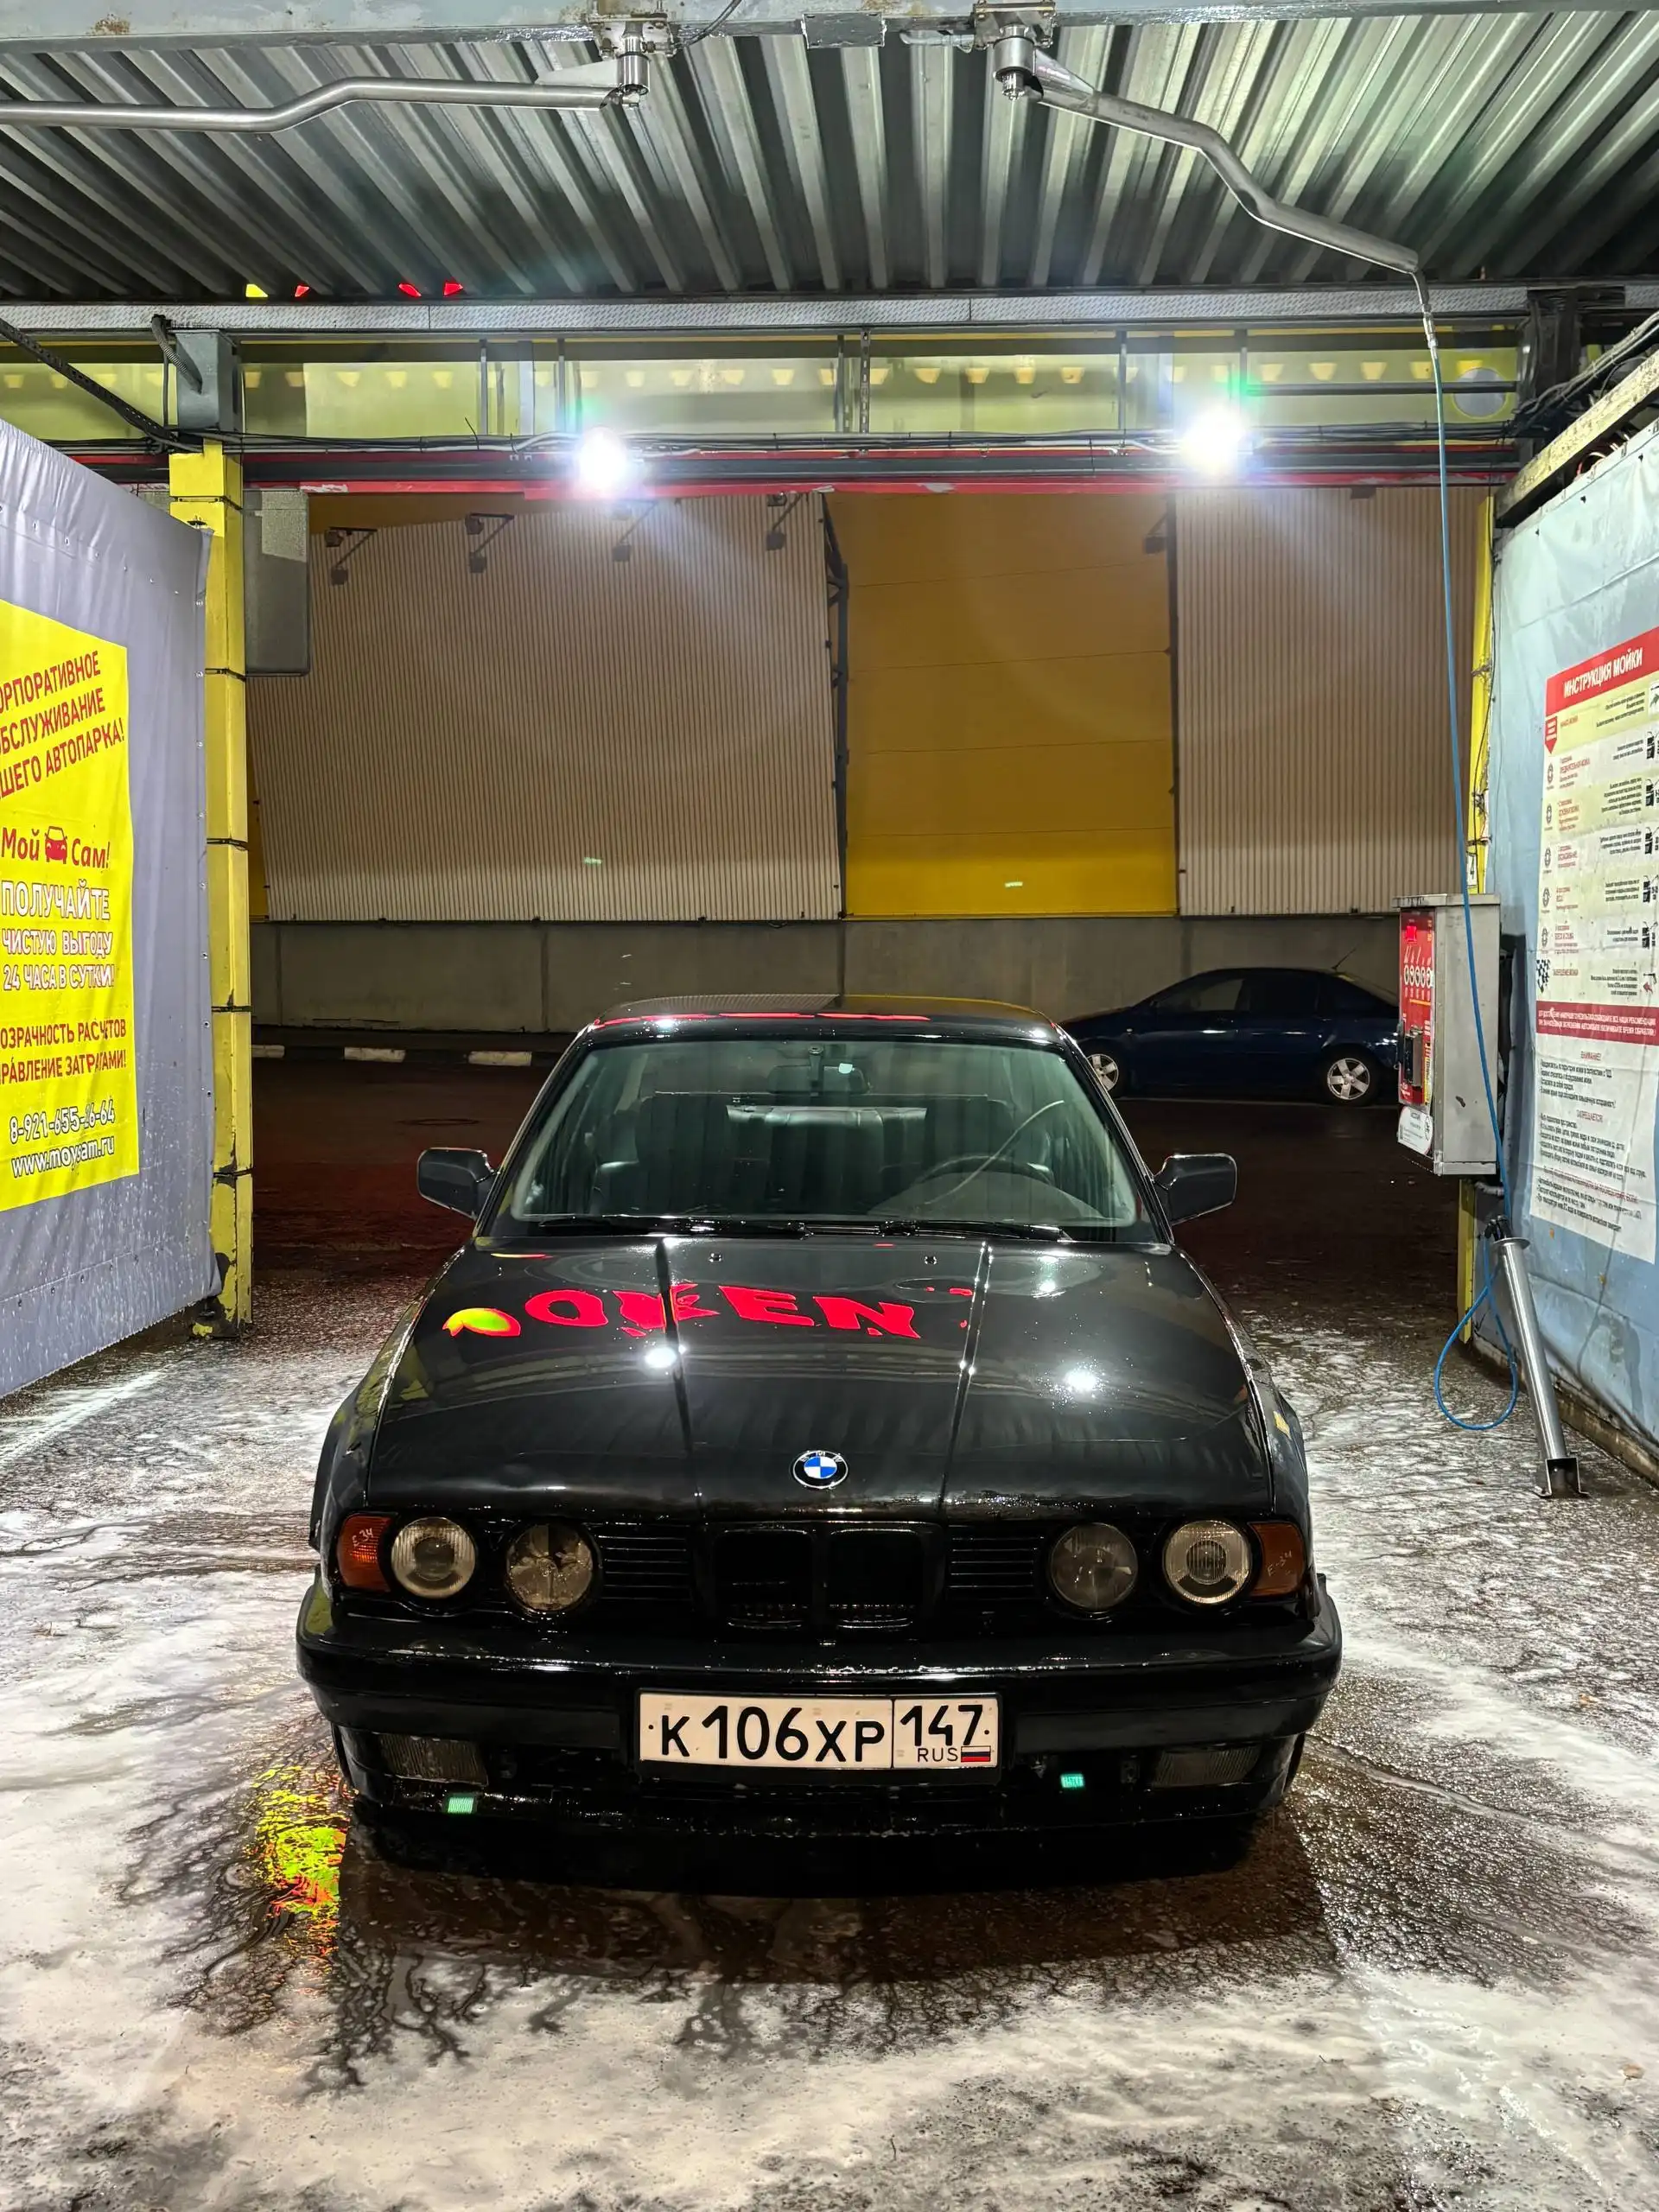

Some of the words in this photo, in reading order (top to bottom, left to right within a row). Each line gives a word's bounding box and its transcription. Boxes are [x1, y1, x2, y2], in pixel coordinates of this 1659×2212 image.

[1563, 666, 1611, 699] ИНСТРУКЦИЯ
[1612, 647, 1643, 677] МОЙКИ
[0, 688, 105, 755] БСЛУЖИВАНИЕ
[0, 755, 41, 799] ШЕГО
[46, 718, 125, 779] АВТОПАРКА!
[1, 827, 40, 861] Мой
[72, 838, 111, 868] Сам!
[1, 878, 111, 919] ПОЛУЧАЙТЕ
[2, 927, 57, 955] ЧИСТУЮ
[62, 931, 113, 960] ВЫГОДУ
[3, 963, 21, 991] 24
[23, 964, 58, 991] ЧАСА
[59, 965, 67, 989] В
[69, 963, 115, 990] СУТКИ!
[0, 1022, 75, 1049] ОЗРАЧНОСТЬ
[0, 1057, 63, 1085] РАВЛЕНИЕ
[11, 1135, 115, 1179] www.moysam.ru
[661, 1705, 885, 1763] К106ХР
[899, 1705, 983, 1747] 147
[917, 1747, 959, 1763] RUS
